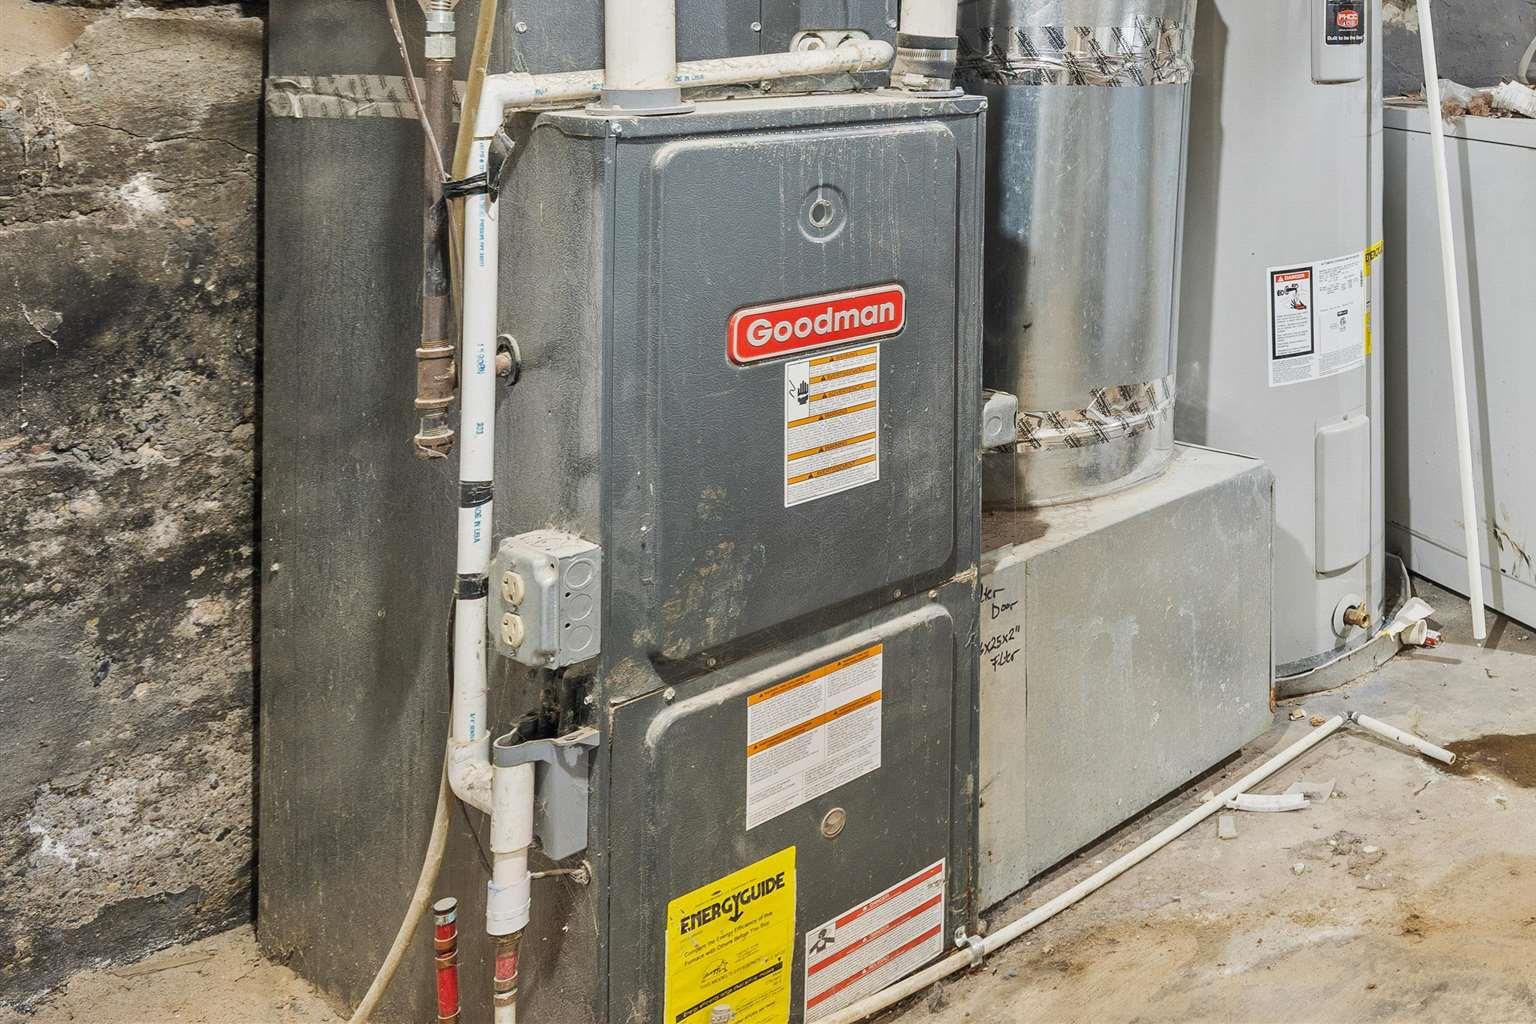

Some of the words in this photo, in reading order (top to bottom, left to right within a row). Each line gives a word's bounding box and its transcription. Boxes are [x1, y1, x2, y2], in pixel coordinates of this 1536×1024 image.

[746, 299, 895, 347] Goodman
[991, 601, 1018, 619] Door
[680, 872, 785, 935] ENERGYGUIDE
